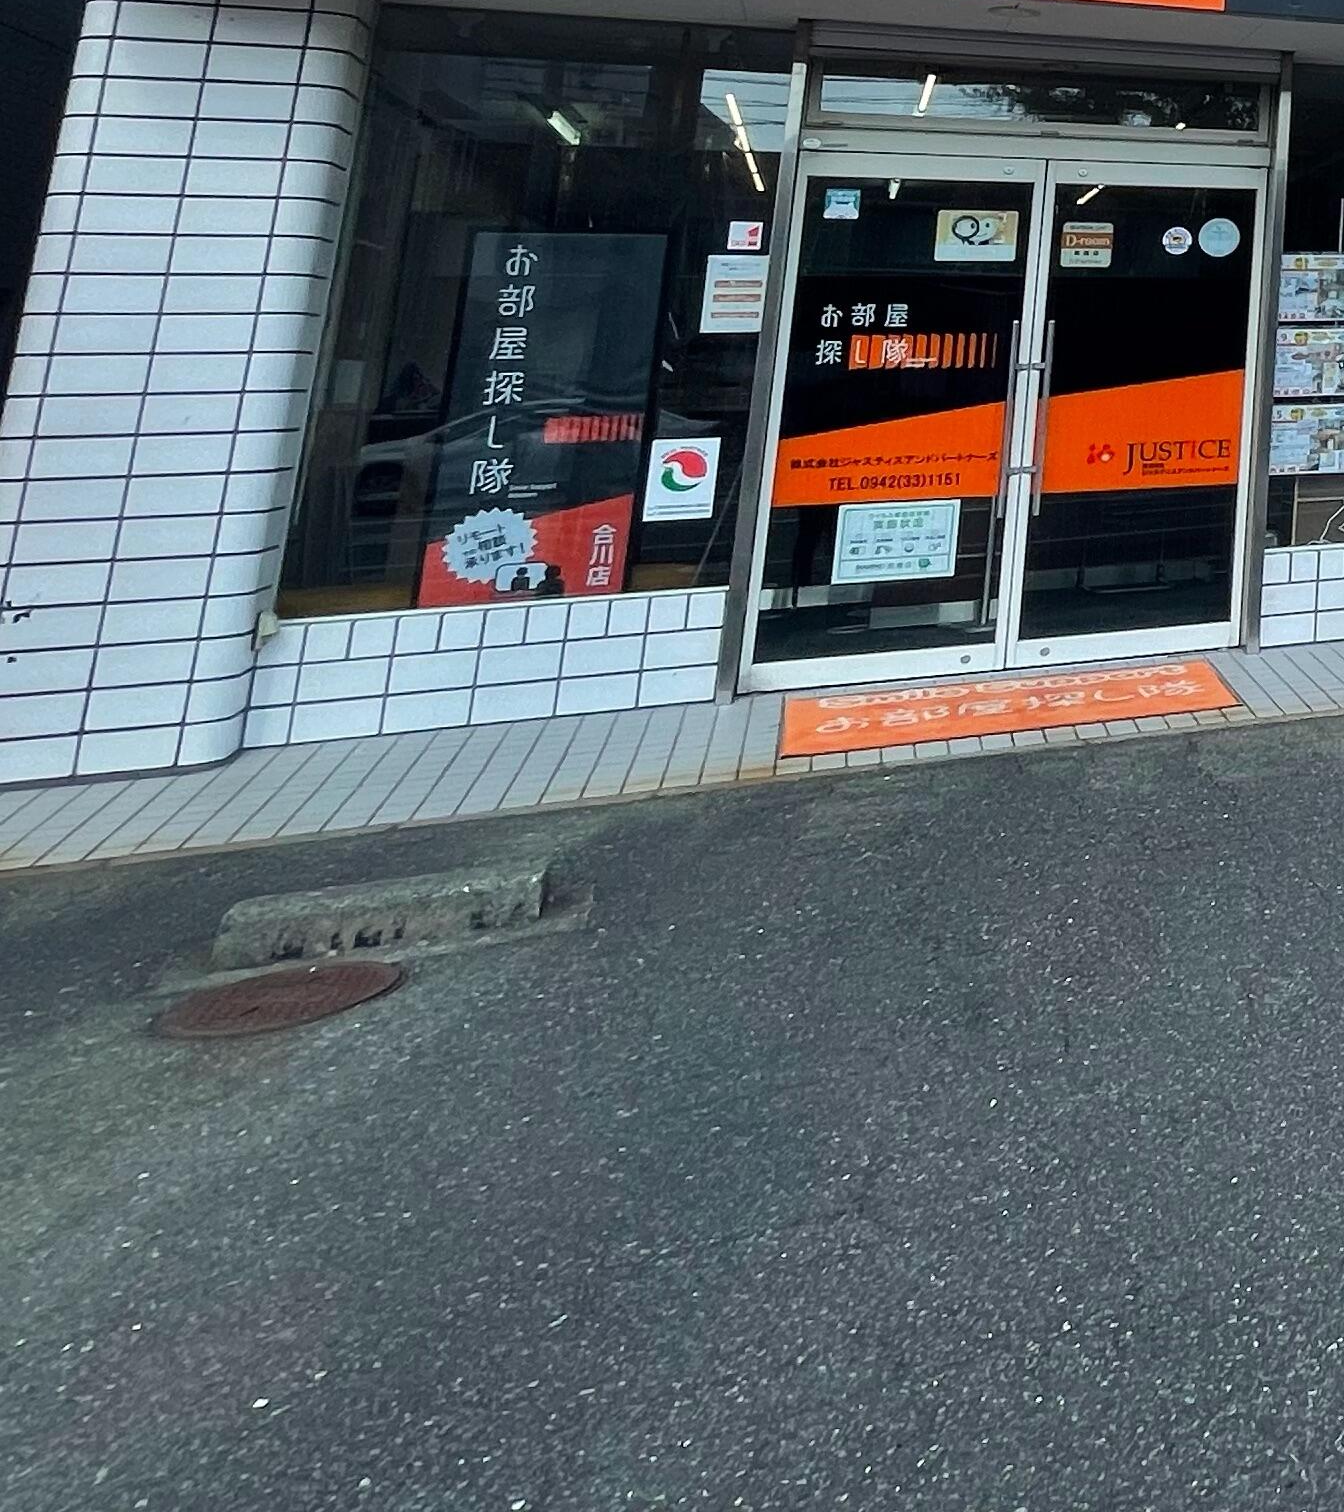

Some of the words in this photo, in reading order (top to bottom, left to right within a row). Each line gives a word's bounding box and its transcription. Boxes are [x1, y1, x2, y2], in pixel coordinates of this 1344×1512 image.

[820, 302, 909, 328] お部屋
[468, 244, 539, 495] お部屋探し隊
[815, 339, 909, 366] 探し隊
[1122, 438, 1232, 476] JUSTICE
[586, 524, 617, 587] 合川店
[816, 679, 1203, 734] お部屋探し隊
